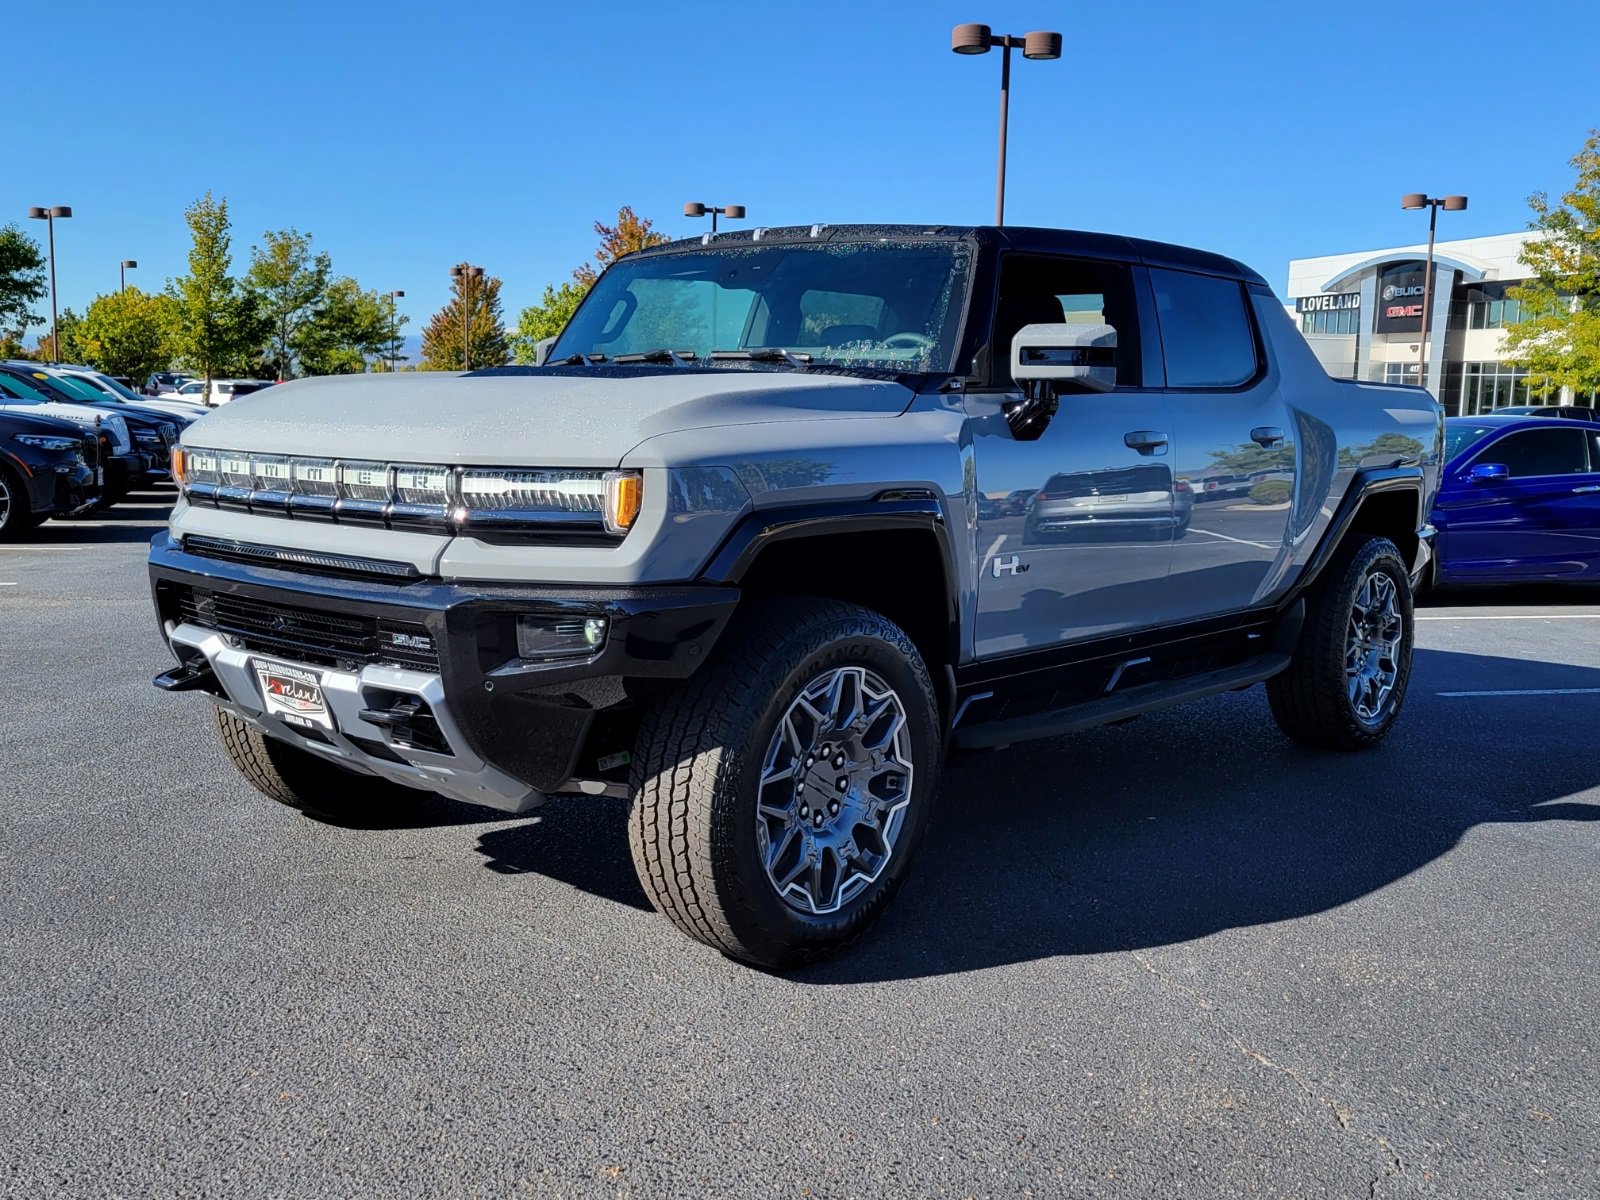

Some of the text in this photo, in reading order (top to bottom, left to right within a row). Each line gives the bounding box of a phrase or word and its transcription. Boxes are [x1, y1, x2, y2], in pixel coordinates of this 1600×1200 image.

[1302, 294, 1360, 311] LOVELAND
[1387, 305, 1422, 317] GMC
[200, 458, 428, 488] HUMMER
[393, 633, 430, 649] GMC
